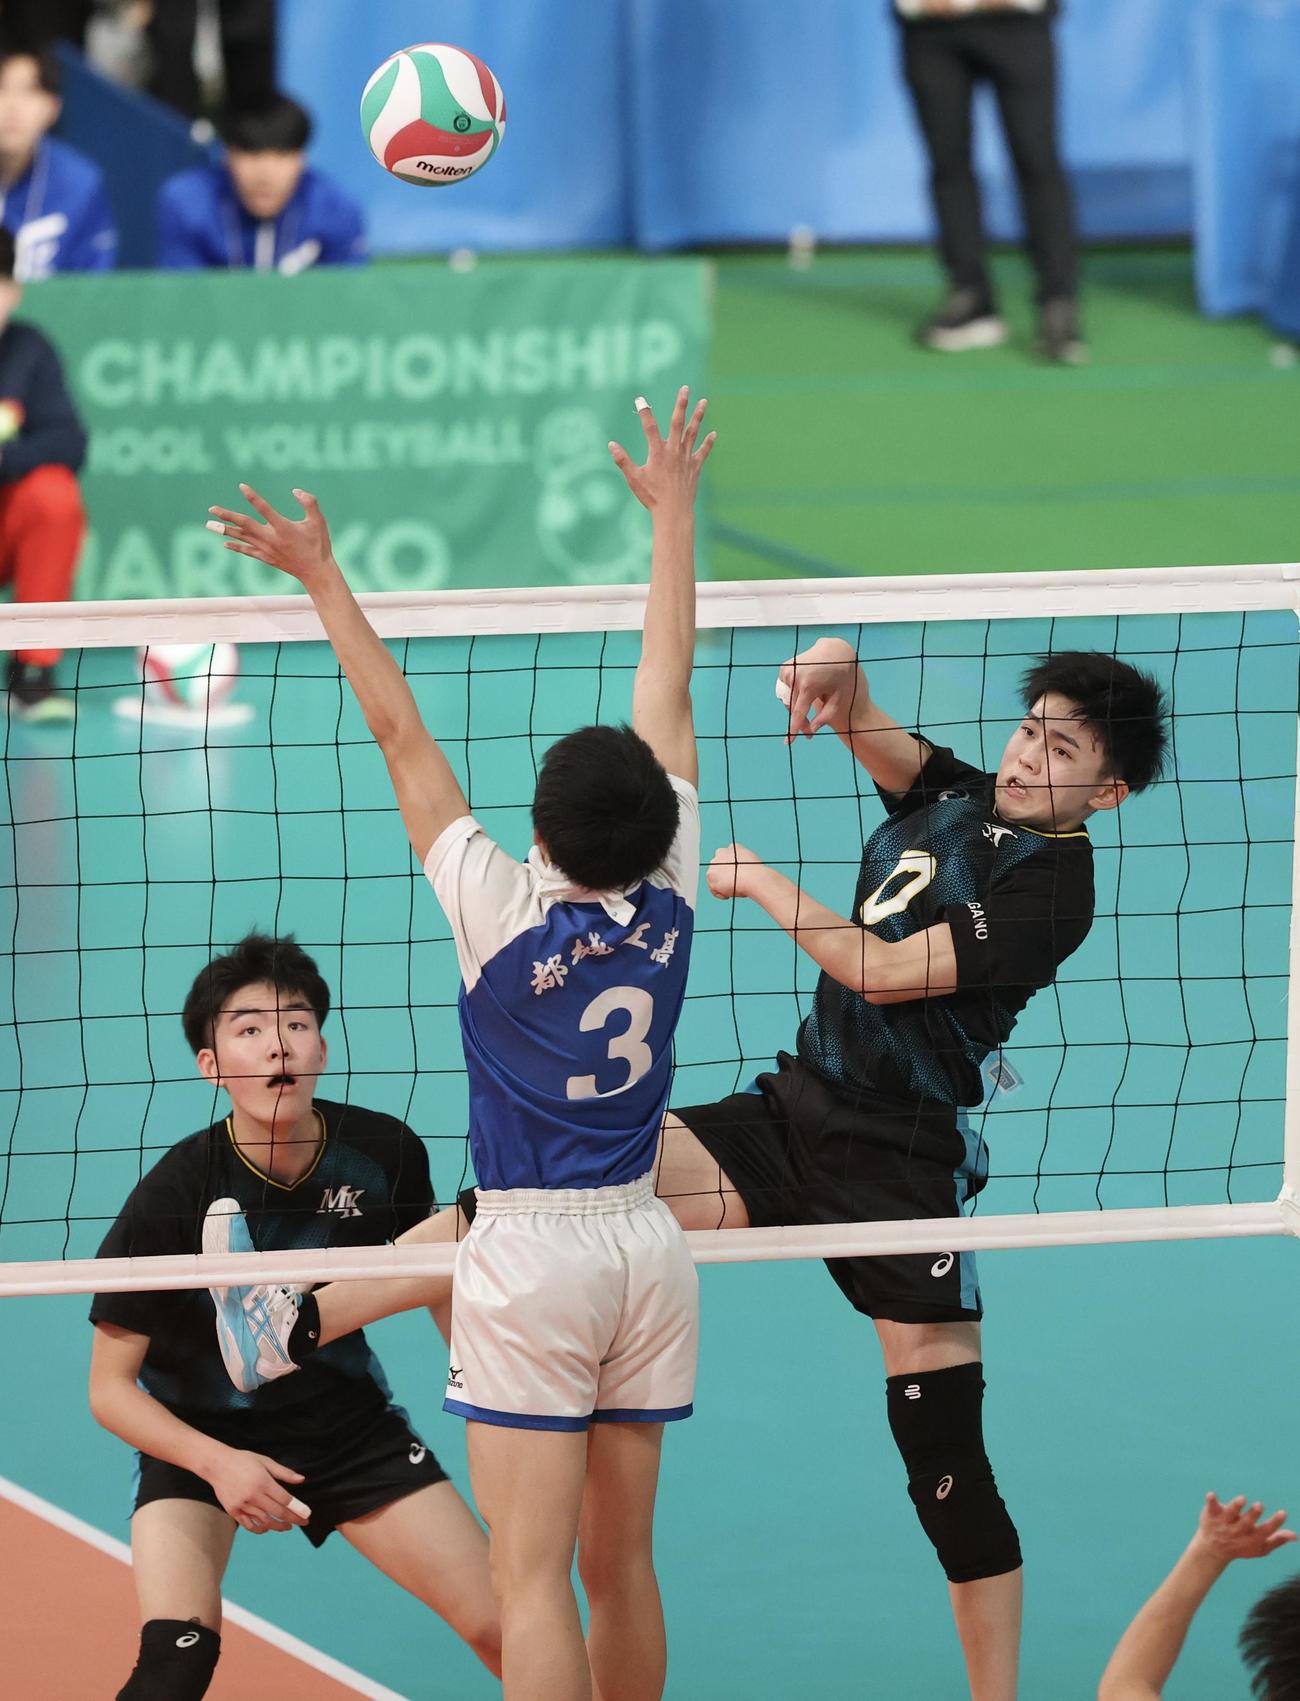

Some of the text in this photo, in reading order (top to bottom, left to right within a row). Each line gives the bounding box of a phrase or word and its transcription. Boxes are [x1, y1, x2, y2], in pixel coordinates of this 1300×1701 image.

[416, 160, 473, 176] molten
[81, 320, 682, 406] CHAMPIONSHIP
[222, 416, 525, 472] VOLLEYBALL
[566, 985, 654, 1100] 3
